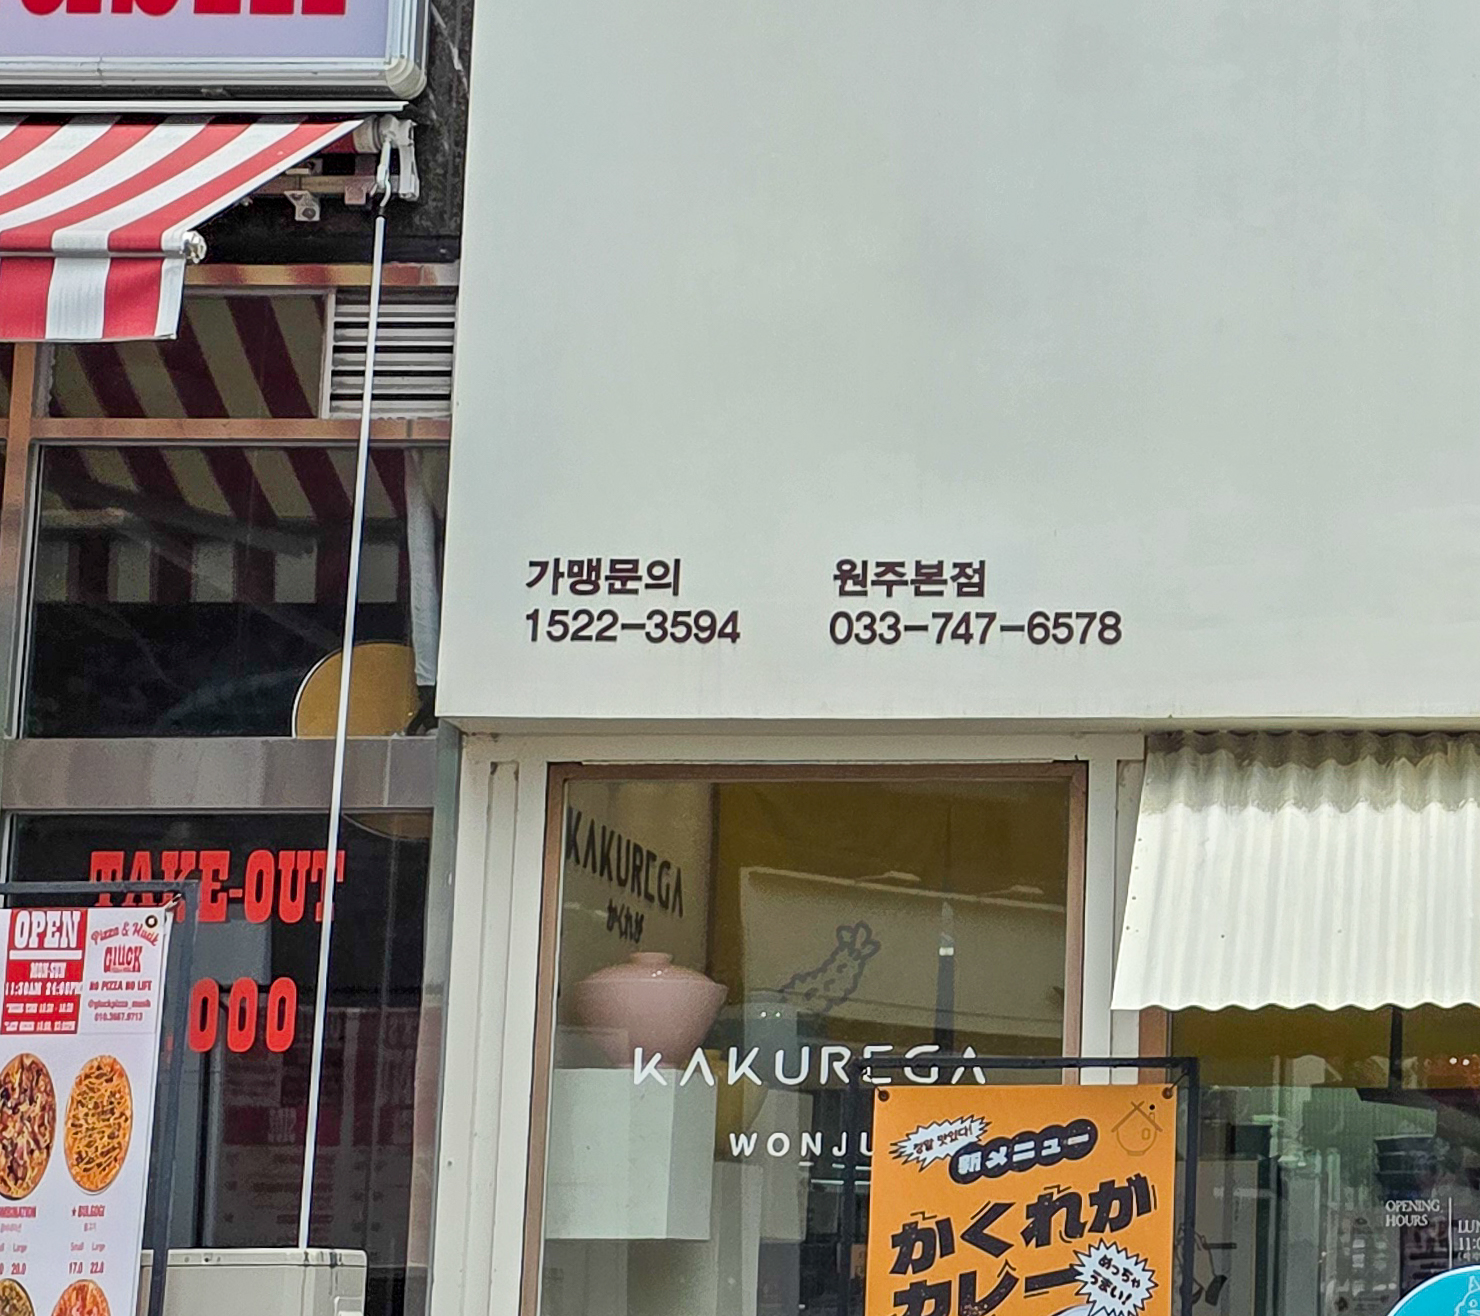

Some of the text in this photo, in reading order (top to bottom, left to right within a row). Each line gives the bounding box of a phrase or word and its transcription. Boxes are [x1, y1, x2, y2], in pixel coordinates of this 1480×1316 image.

[526, 557, 682, 597] 가맹문의
[832, 559, 988, 598] 원주본점
[526, 609, 741, 644] 1522-3594
[829, 611, 1123, 646] 033-747-6578
[88, 850, 346, 924] TAKE-OUT
[14, 910, 82, 949] OPEN
[633, 1045, 987, 1086] KAKUREGA
[957, 1133, 1090, 1175] 新メニュー
[889, 1173, 1152, 1275] かくれが
[1385, 1199, 1441, 1213] OPENING
[1385, 1214, 1429, 1227] HOURS
